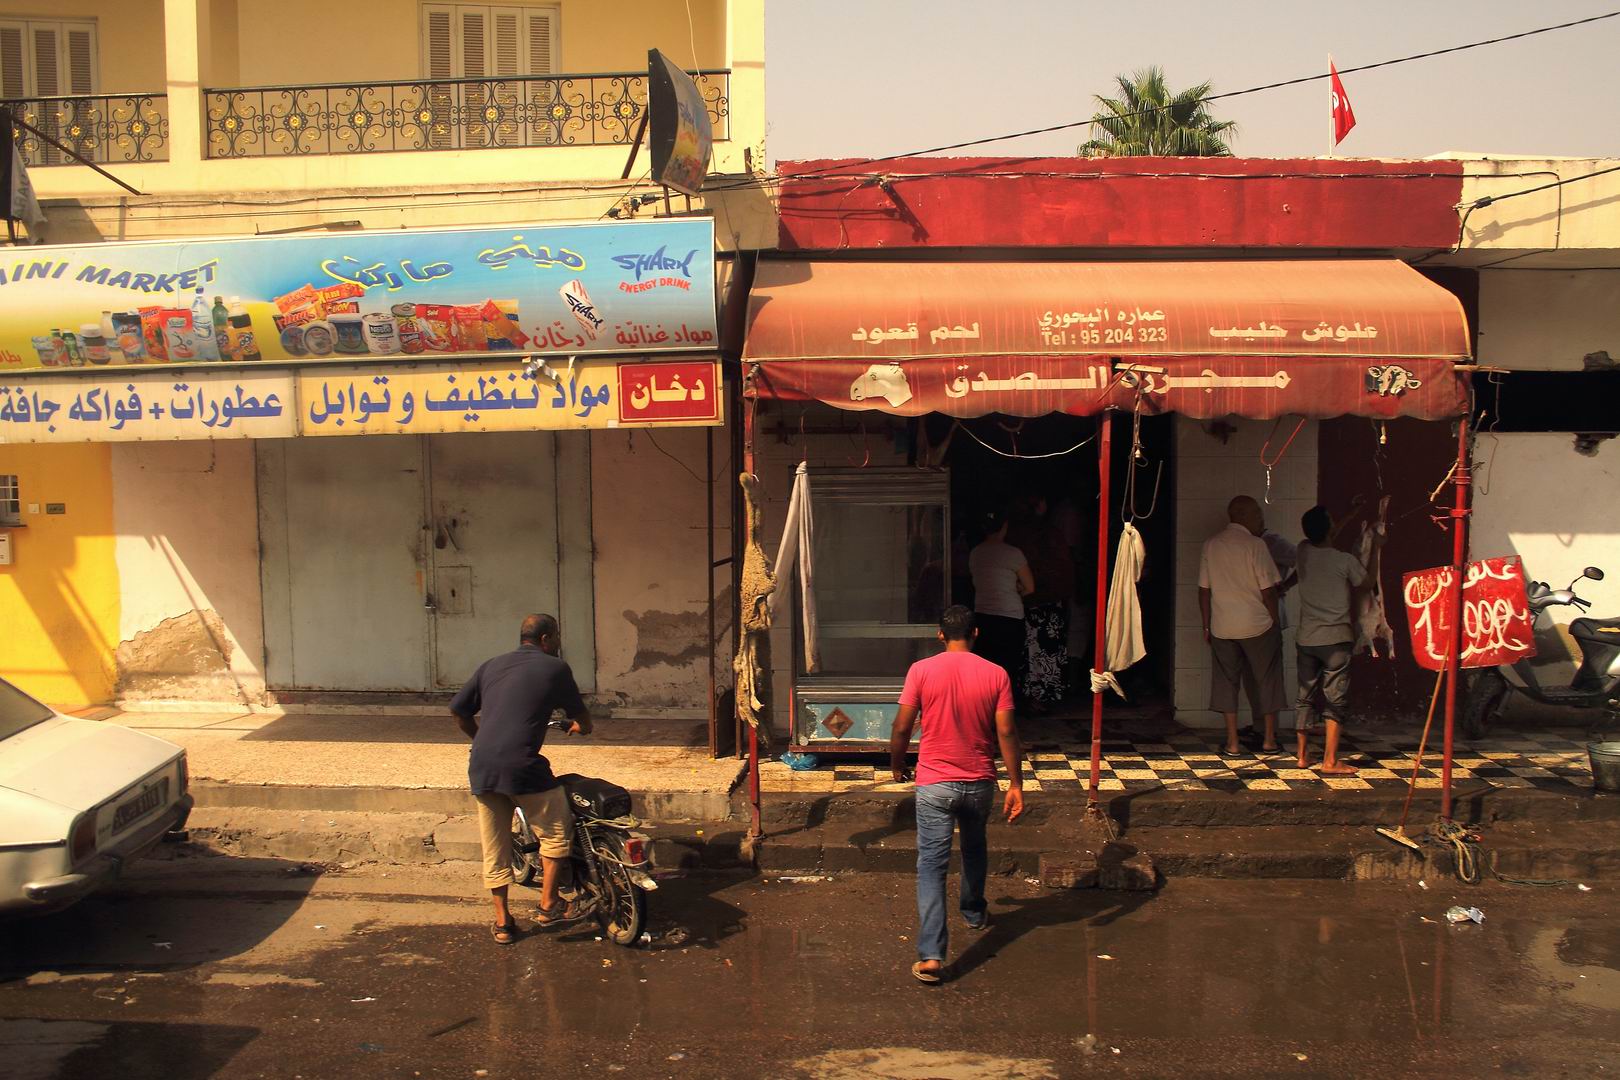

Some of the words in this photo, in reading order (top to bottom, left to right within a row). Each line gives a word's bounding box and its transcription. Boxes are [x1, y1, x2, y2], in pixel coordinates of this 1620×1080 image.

[478, 235, 586, 271] ميني
[611, 245, 699, 281] SHARK
[75, 261, 218, 293] MARKET
[619, 277, 657, 293] ENERGY
[659, 277, 691, 290] DRINK
[564, 292, 604, 329] SHARK
[674, 323, 713, 344] مواد
[852, 322, 919, 344] قعود
[930, 322, 980, 344] لحم
[1043, 331, 1066, 345] Tel
[1080, 330, 1100, 344] 95
[1104, 328, 1134, 343] 204
[1138, 327, 1168, 342] 323
[1208, 321, 1288, 341] حليب
[1302, 321, 1378, 342] علوش
[425, 372, 539, 421] تنظيف
[552, 374, 610, 417] مواد
[630, 374, 705, 410] دخان
[945, 365, 1108, 398] الصدق
[0, 386, 61, 433] جافة
[69, 384, 142, 430] فواكه
[170, 383, 283, 428] عطورات
[310, 376, 391, 426] توابل
[395, 391, 414, 424] و
